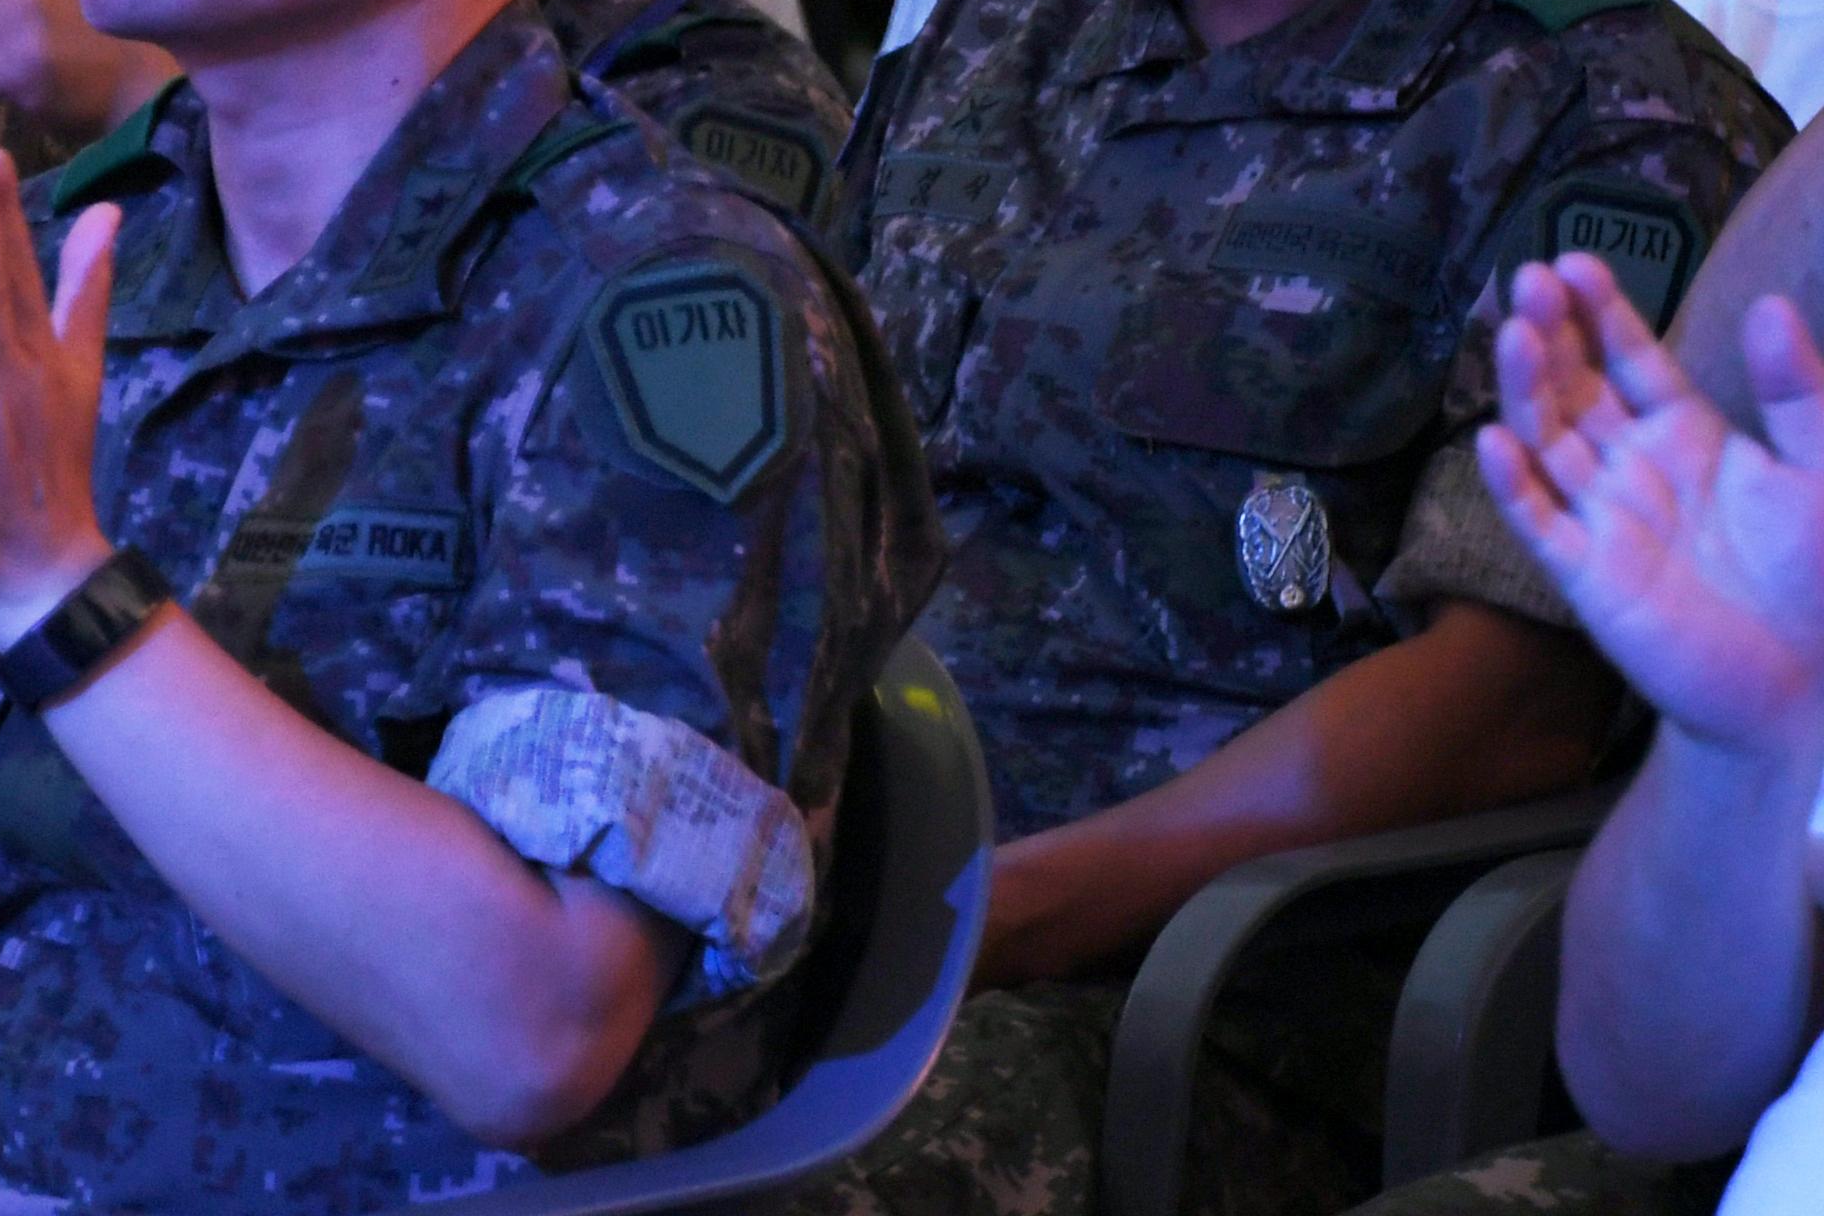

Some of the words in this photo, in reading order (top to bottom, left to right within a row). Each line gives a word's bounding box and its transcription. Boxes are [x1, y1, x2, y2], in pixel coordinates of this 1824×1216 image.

[1572, 212, 1672, 262] 이기자
[631, 299, 747, 352] 이기자
[368, 523, 448, 562] ROKA
